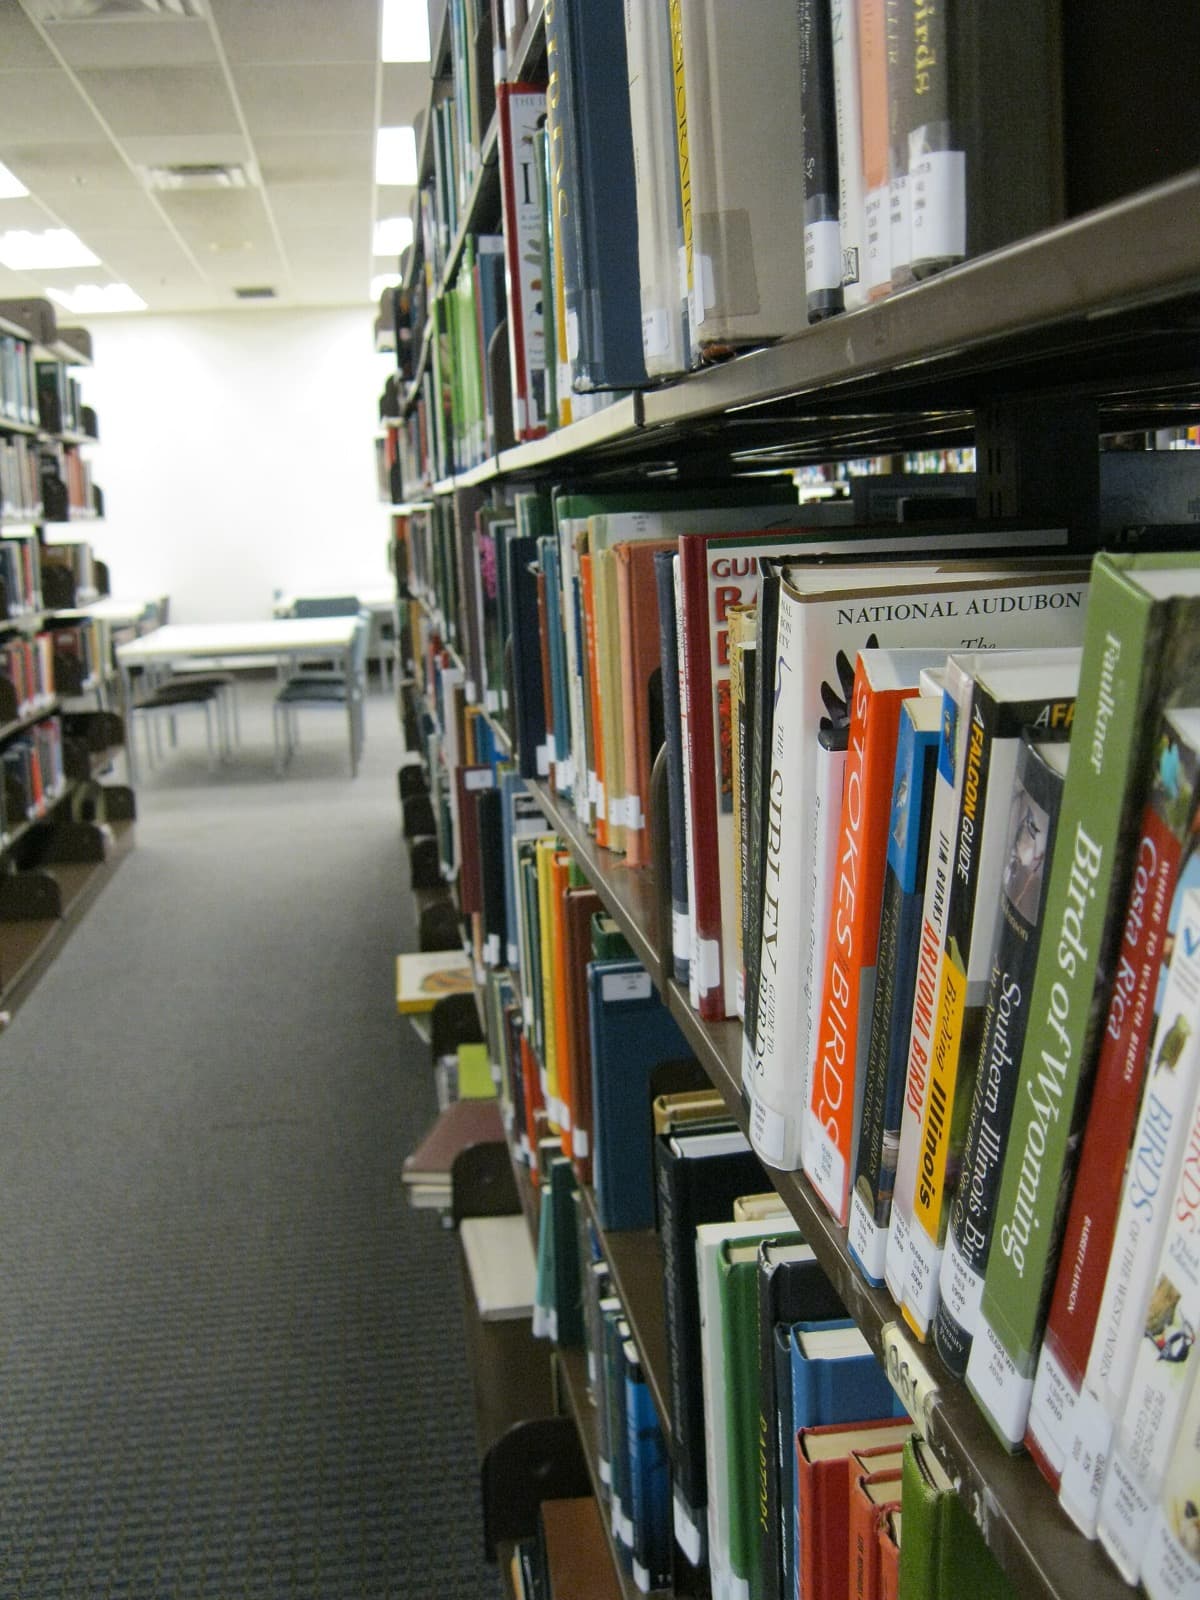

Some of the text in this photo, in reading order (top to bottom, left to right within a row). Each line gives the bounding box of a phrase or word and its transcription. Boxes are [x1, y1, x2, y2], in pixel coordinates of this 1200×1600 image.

[914, 0, 936, 95] irds
[711, 557, 758, 578] GUI
[837, 592, 1082, 625] NATIONAL AUDUBON
[1035, 705, 1051, 728] A
[1091, 632, 1121, 774] Faulkner
[836, 680, 868, 957] STOKES
[938, 830, 950, 863] JIM
[957, 704, 985, 885] A FALCON GUIDE
[915, 918, 941, 1041] ARIZONA
[1108, 837, 1158, 1041] Costa Rica
[1124, 861, 1169, 1082] WHERE TO WATCH BIRDS
[819, 962, 849, 1146] BIRDS
[907, 1035, 929, 1124] BIRDS
[985, 973, 1021, 1113] Southern
[1001, 822, 1103, 1278] Birds of Wyoming
[919, 1077, 947, 1210] Illinois
[968, 1116, 1001, 1217] Illinois
[1130, 1094, 1173, 1223] BIRDS
[960, 1216, 985, 1265] Bir
